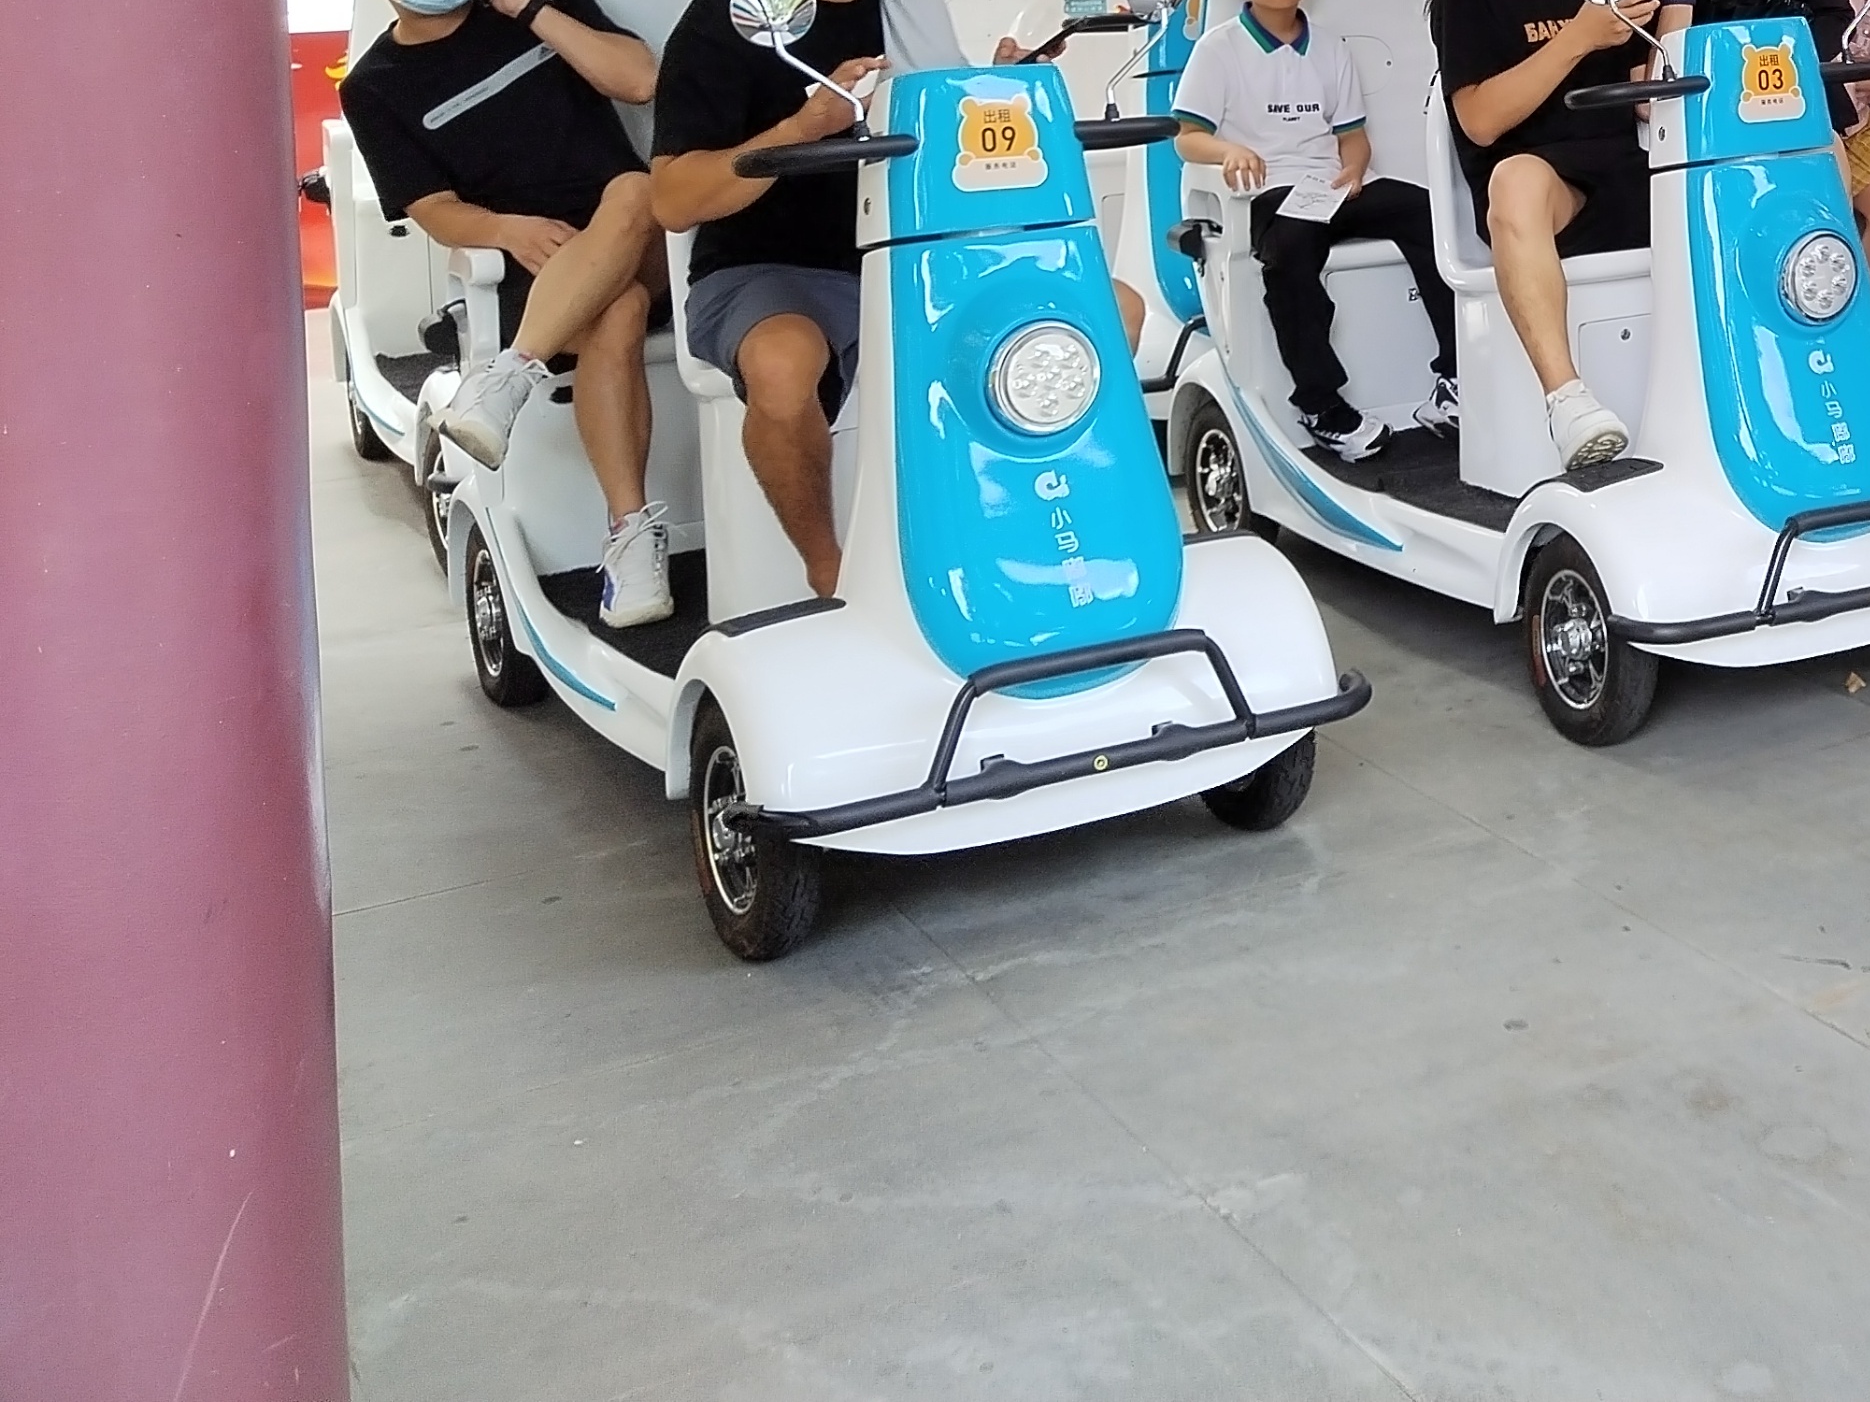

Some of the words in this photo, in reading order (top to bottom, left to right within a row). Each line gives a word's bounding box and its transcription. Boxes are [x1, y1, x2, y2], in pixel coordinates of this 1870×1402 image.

[1759, 54, 1779, 67] 出租
[1757, 68, 1784, 91] 03
[1267, 103, 1291, 114] SAVE
[983, 109, 1011, 124] 出租
[980, 125, 1017, 153] 09
